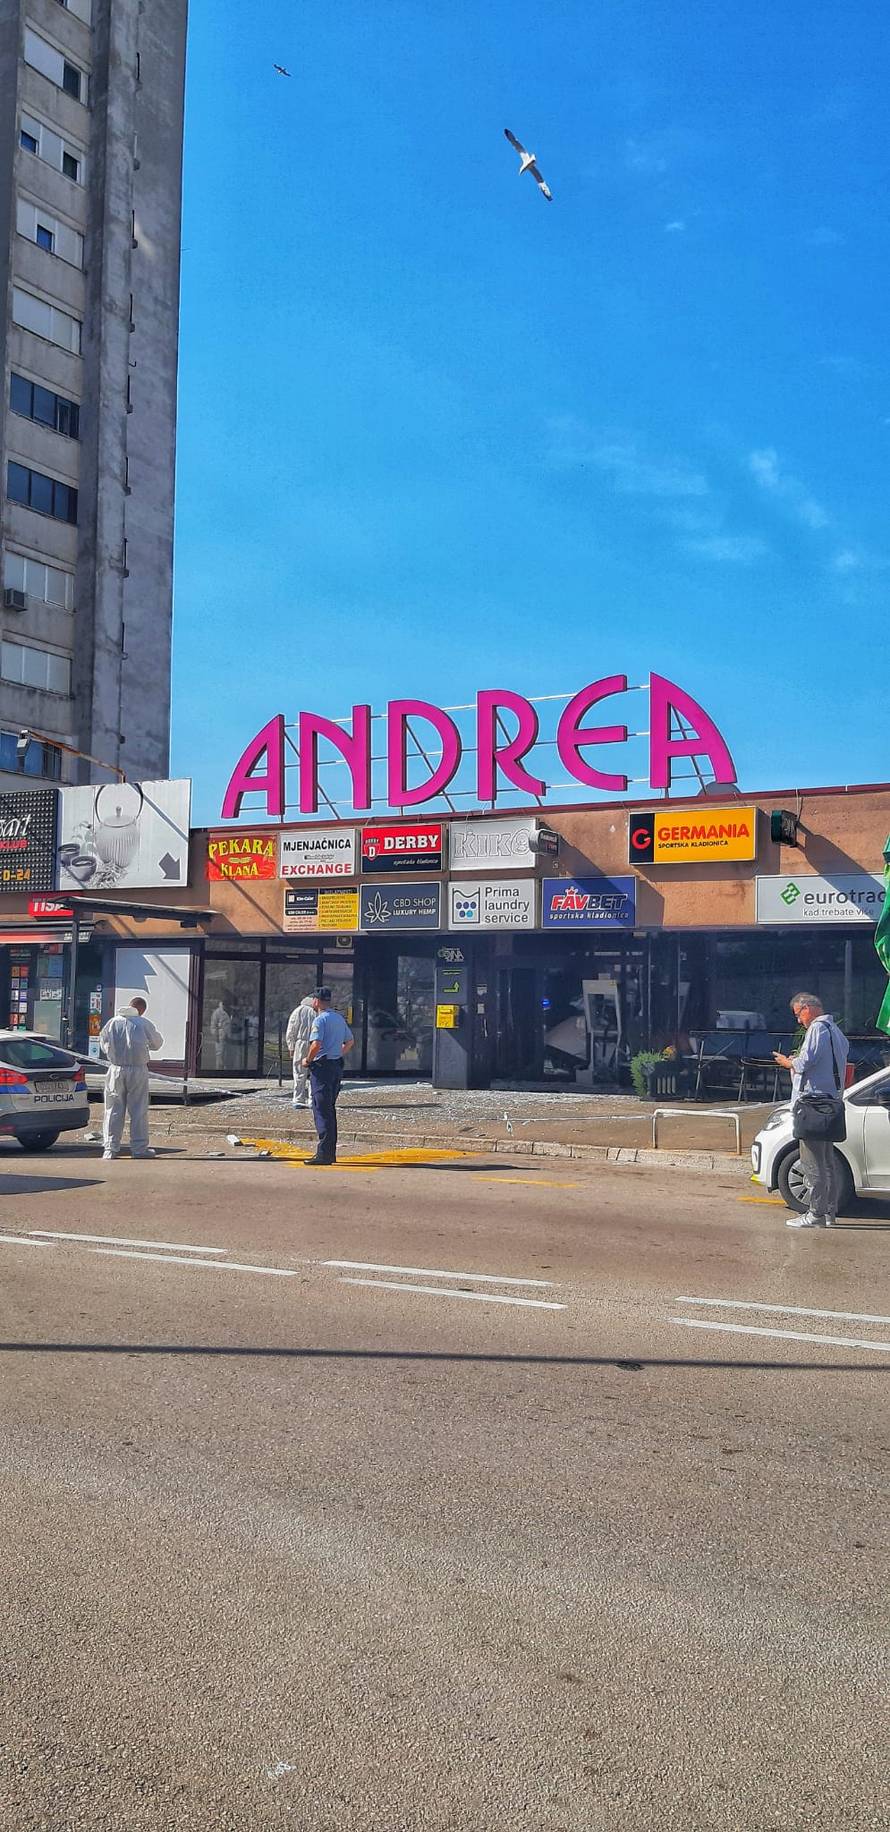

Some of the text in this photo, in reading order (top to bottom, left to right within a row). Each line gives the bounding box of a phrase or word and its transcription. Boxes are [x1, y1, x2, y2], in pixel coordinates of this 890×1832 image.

[221, 671, 737, 819] ANDREA
[657, 823, 750, 841] GERMANIA
[208, 838, 274, 859] PEKARA
[283, 837, 352, 852] MJENJAČNICA
[384, 835, 439, 850] DERBY
[691, 840, 729, 848] KLADIONICA
[221, 863, 259, 876] KLANA
[282, 863, 352, 875] EXCHANGE
[484, 886, 520, 897] Prima
[393, 897, 437, 907] CBD SHOP
[484, 899, 530, 912] laundry
[551, 893, 628, 911] FAVBET
[393, 908, 417, 916] LUXURY
[484, 912, 529, 923] service
[550, 911, 629, 920] sportska kladionica
[803, 908, 819, 916] kad
[822, 908, 854, 916] trebate
[34, 1093, 75, 1104] POLICIJA
